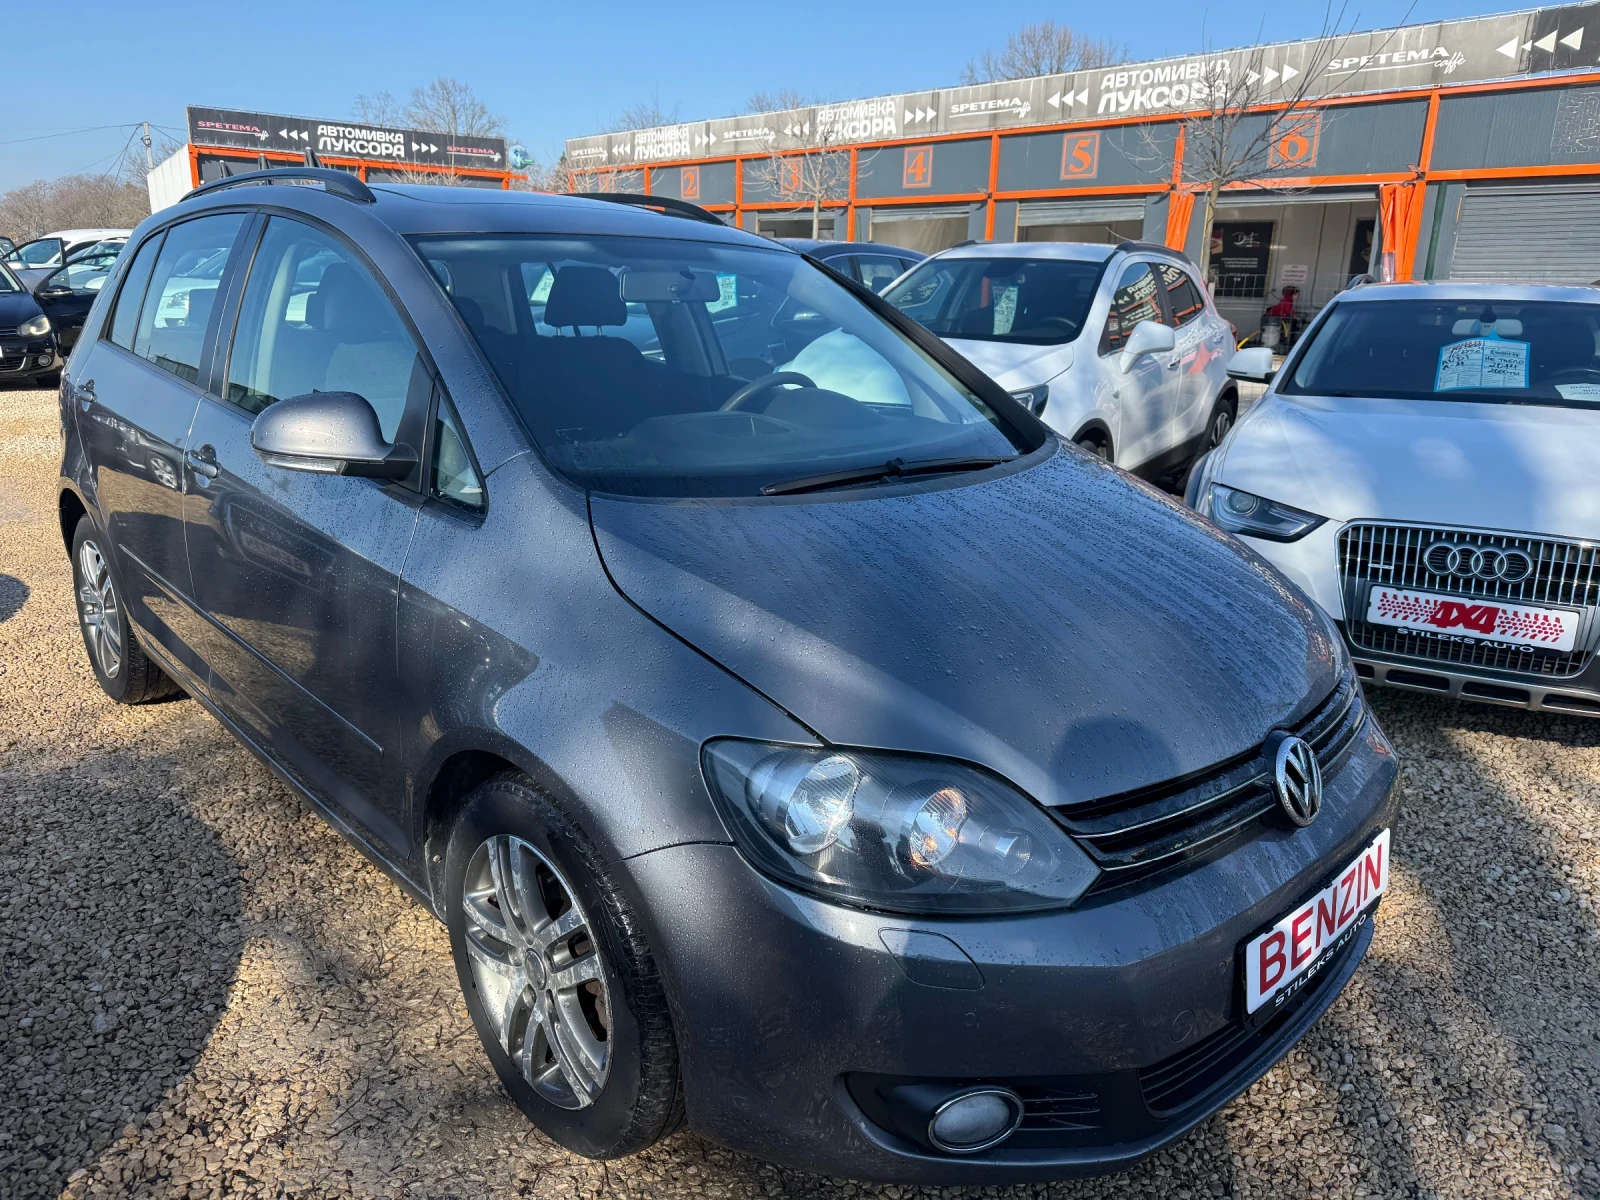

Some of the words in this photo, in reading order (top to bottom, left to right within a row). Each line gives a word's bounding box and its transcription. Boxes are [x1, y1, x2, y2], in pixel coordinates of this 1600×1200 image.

[1327, 46, 1450, 71] SPETEMA
[1100, 59, 1230, 90] АВТОМИВКА
[951, 97, 1022, 114] SPETEMA
[1097, 80, 1230, 114] ЛУКСОРА
[817, 101, 896, 123] АВТОМИВКА
[198, 121, 260, 133] SPETEMA
[317, 125, 404, 144] АВТОМИВКА
[634, 127, 689, 144] АВТОМИВКА
[723, 127, 770, 139] SPETEMA
[318, 137, 405, 158] ЛУКСОРА
[446, 146, 495, 155] SPETEMA
[571, 147, 603, 156] SPETEMA
[634, 141, 691, 160] ЛУКСОРА
[1278, 120, 1312, 161] 6
[907, 152, 927, 181] 4
[1069, 139, 1092, 173] 5
[684, 172, 696, 195] 2
[789, 163, 800, 193] 3
[1397, 627, 1476, 645] STILEKS
[1480, 638, 1535, 653] AUTO
[1259, 843, 1383, 997] BENZIN
[1274, 948, 1334, 1008] STILEKS
[1335, 913, 1367, 953] AUTO
